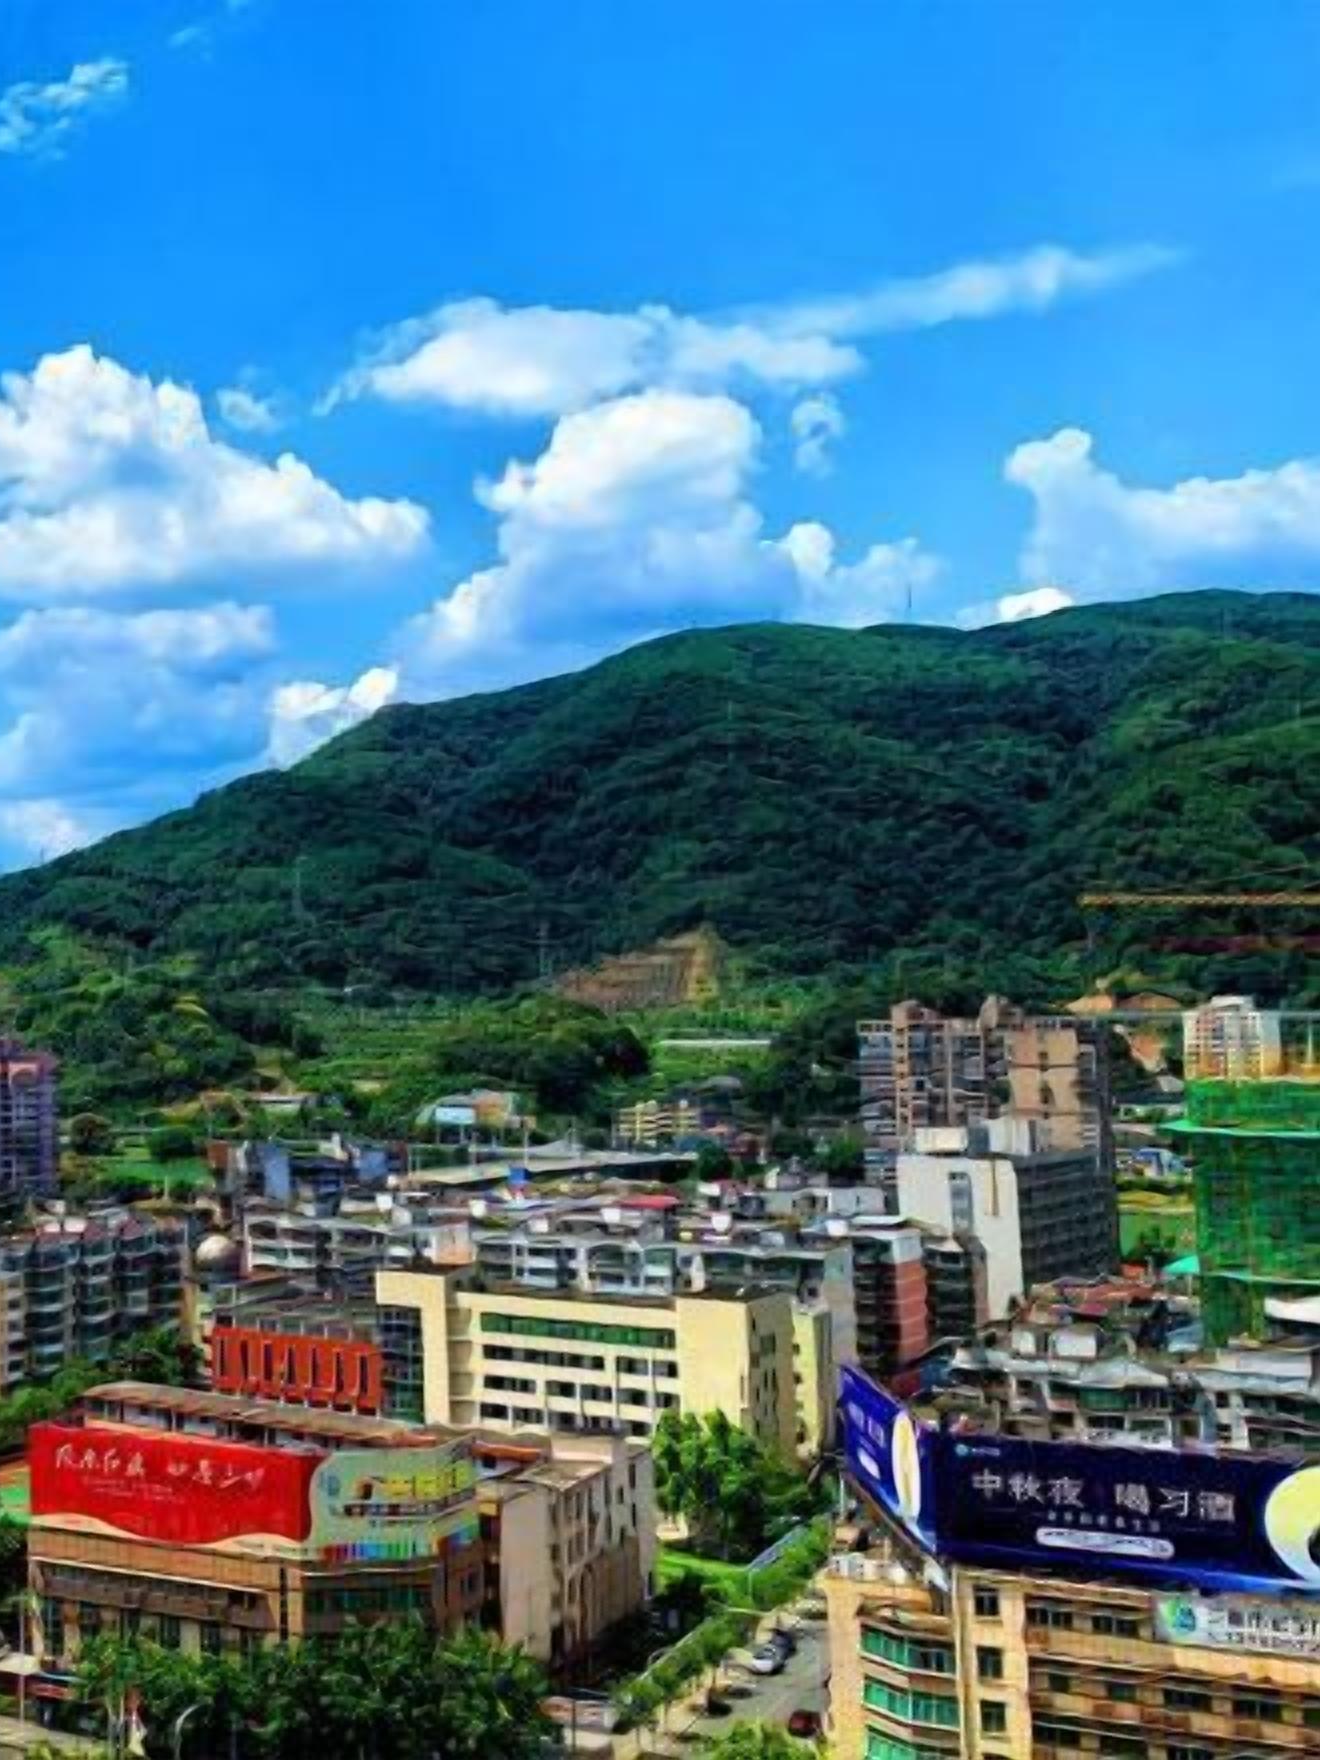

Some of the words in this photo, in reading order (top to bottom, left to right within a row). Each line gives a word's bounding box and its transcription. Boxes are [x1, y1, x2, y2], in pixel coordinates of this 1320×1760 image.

[972, 1468, 1084, 1508] 中秋夜
[1114, 1482, 1236, 1522] 喝习酒
